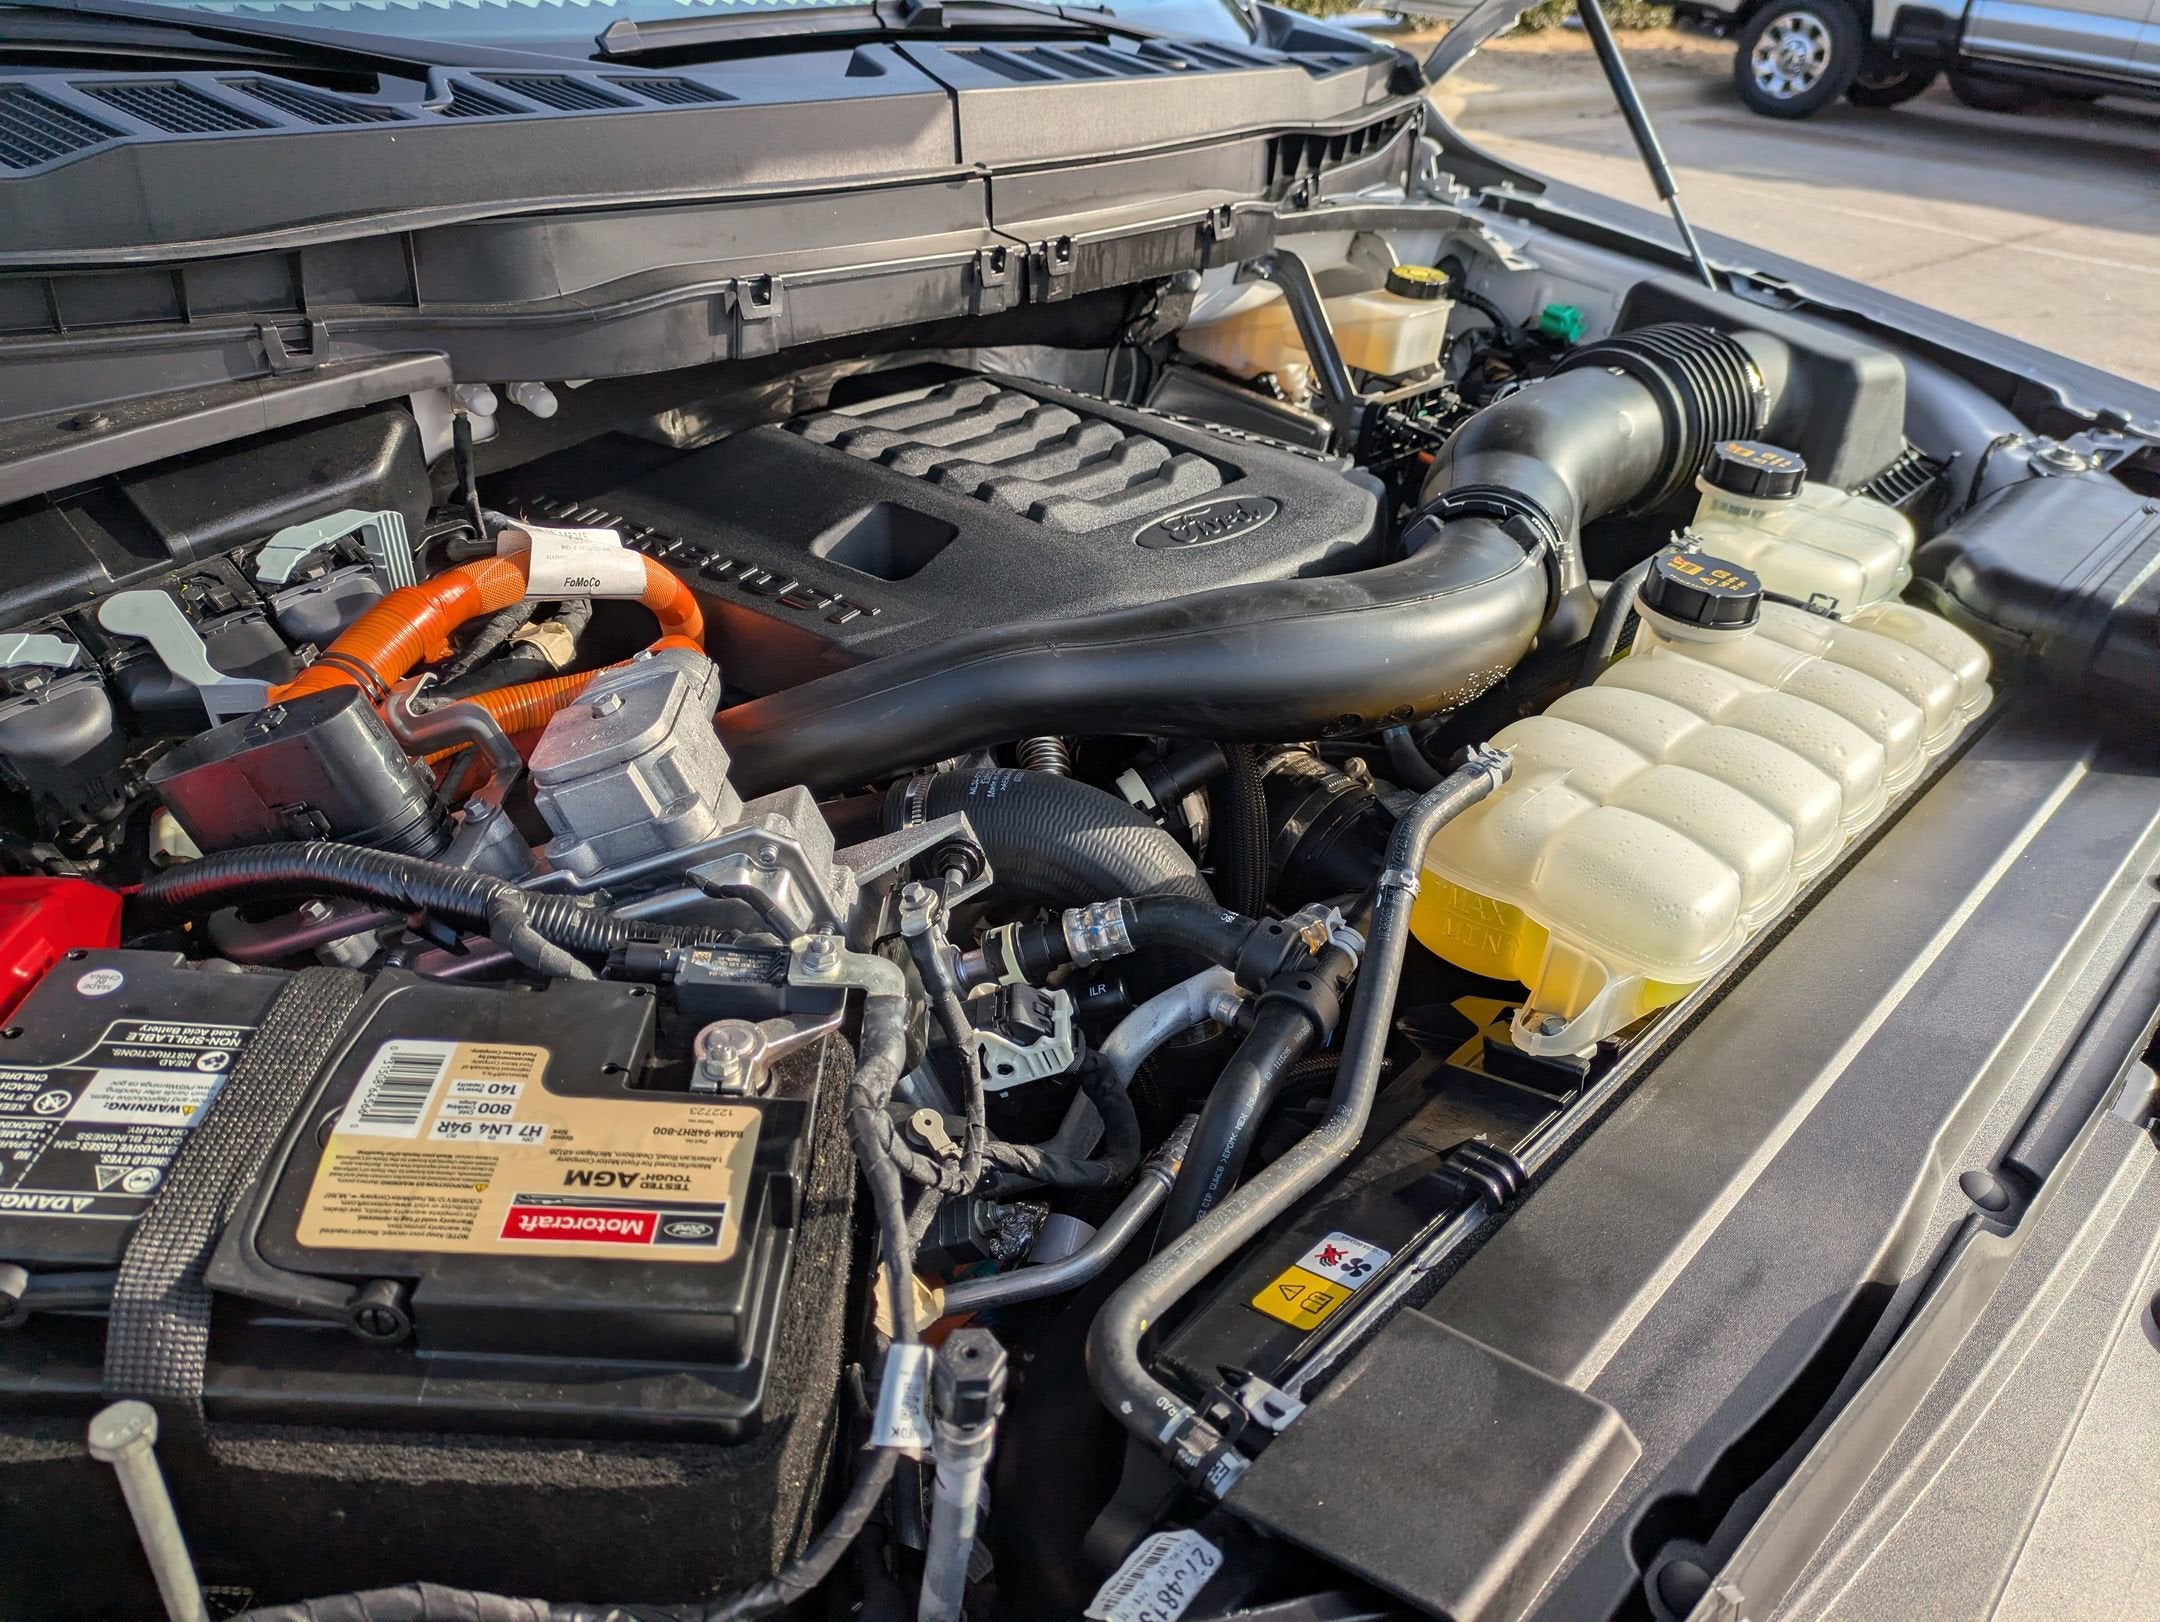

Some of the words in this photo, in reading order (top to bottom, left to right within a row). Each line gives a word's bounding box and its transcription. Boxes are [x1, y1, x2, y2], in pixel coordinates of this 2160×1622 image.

[1160, 503, 1253, 543] Ford
[563, 577, 601, 588] FoMoCo
[1447, 886, 1507, 927] MAX
[1442, 917, 1502, 954] MIN
[1089, 983, 1107, 998] ILR
[139, 1024, 186, 1036] Battery
[188, 1028, 212, 1037] Acid
[213, 1030, 240, 1038] Lead
[126, 1032, 240, 1048] NON-SPILLABLE
[111, 1048, 196, 1060] INSTRUCTIONS.
[159, 1059, 192, 1067] READ
[1, 1083, 42, 1091] REACH
[488, 1084, 516, 1095] 140
[15, 1093, 33, 1101] OF
[0, 1104, 26, 1112] KEE
[103, 1102, 181, 1114] WARNING:
[478, 1103, 512, 1115] 800
[689, 1107, 733, 1117] 122723
[1235, 1112, 1248, 1130] MEX
[128, 1126, 170, 1135] INJURY.
[438, 1122, 472, 1133] 94R
[479, 1123, 513, 1135] LN4
[519, 1125, 542, 1136] H7
[653, 1126, 743, 1138] BAGM-94RH7-800
[76, 1132, 143, 1143] BLINDNESS
[144, 1135, 182, 1145] CAUSE
[0, 1140, 32, 1149] SPAR
[52, 1140, 80, 1150] CAN
[80, 1141, 117, 1152] GASES
[119, 1143, 177, 1155] EXPLOSIVE
[13, 1150, 32, 1160] NO
[100, 1153, 131, 1165] EYES.
[555, 1156, 594, 1165] Company
[133, 1155, 172, 1167] SHIELD
[594, 1158, 619, 1166] Motor
[620, 1159, 640, 1167] Ford
[654, 1160, 712, 1170] Manufactured
[563, 1170, 640, 1188] AGM
[640, 1182, 690, 1191] TESTED
[0, 1194, 71, 1210] DANG
[518, 1213, 645, 1236] Motorcraft
[1156, 1396, 1178, 1417] RAD
